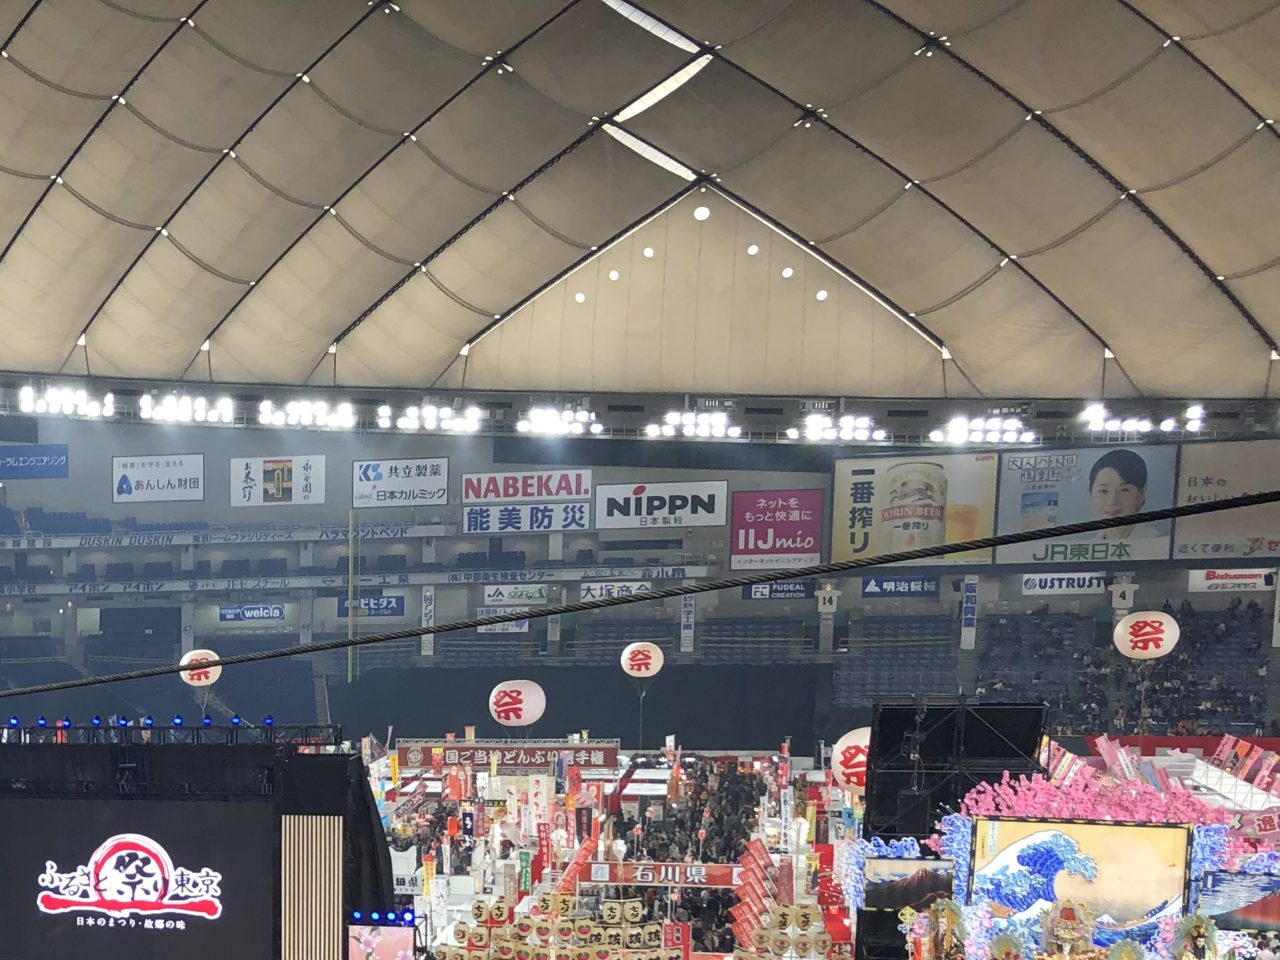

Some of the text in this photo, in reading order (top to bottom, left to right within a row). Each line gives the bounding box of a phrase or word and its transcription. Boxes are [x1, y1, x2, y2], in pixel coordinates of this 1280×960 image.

[1008, 455, 1077, 470] 大人の休日
[387, 464, 442, 479] 共立製薬
[134, 477, 200, 491] あんしん財団
[1187, 476, 1227, 487] 日本の
[376, 488, 446, 501] 日本カルミック
[756, 497, 800, 509] ネットを
[467, 504, 586, 531] 能美防災
[744, 510, 813, 522] もっと快適に
[849, 468, 876, 554] 一番搾り
[639, 516, 682, 526] 日本製粉
[893, 521, 929, 531] 一番搾り
[79, 535, 174, 547] DUSKIN DUSKIN
[738, 528, 815, 550] IIJmio
[1032, 543, 1132, 562] JR東日本
[1205, 570, 1262, 581] Bishamon
[772, 584, 806, 592] FUDEAL
[1038, 576, 1105, 590] USTRUST
[771, 591, 806, 599] CREATION
[822, 595, 833, 606] 14
[1119, 591, 1127, 601] 4
[244, 604, 280, 618] welcia
[1129, 619, 1166, 651] 祭
[629, 649, 652, 672] 祭
[493, 688, 524, 721] 祭
[39, 852, 221, 901] ふるさと祭り東京
[632, 865, 708, 884] 石川県
[76, 917, 186, 930] 日本のまつり・故郷の味
